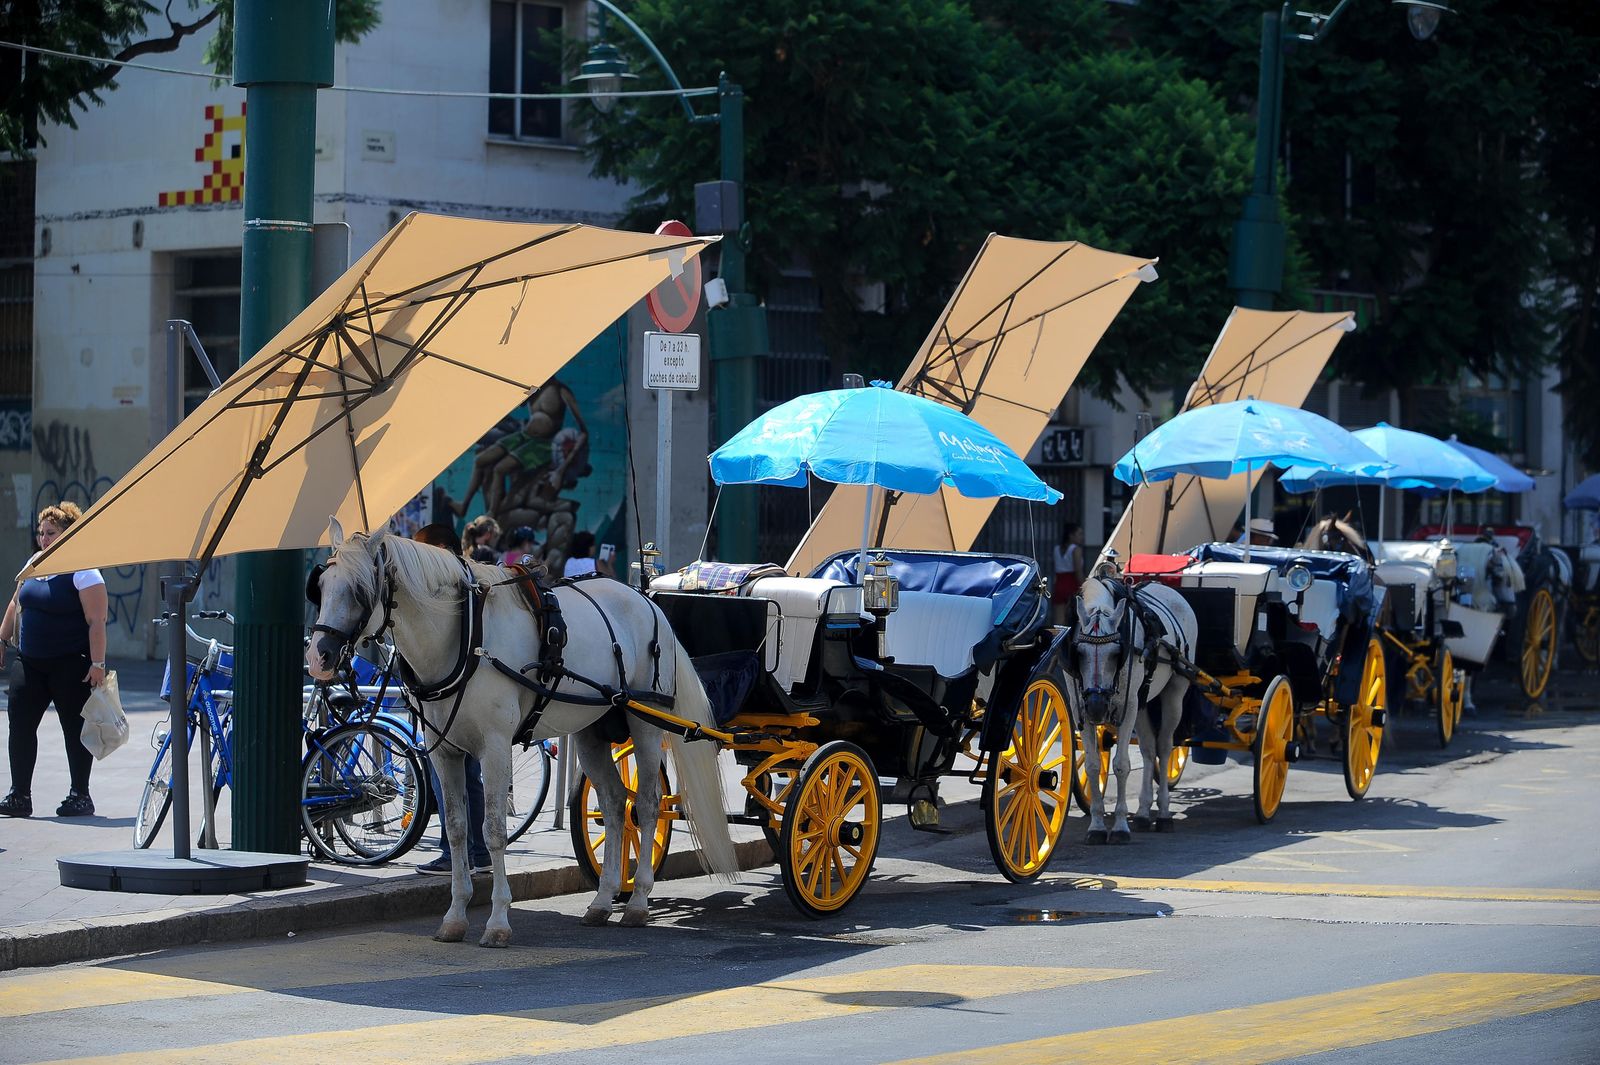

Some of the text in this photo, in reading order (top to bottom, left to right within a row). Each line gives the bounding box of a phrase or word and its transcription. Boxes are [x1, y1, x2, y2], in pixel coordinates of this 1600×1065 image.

[660, 340, 667, 352] De
[663, 356, 685, 369] excepto
[650, 372, 697, 384] coches de caballos
